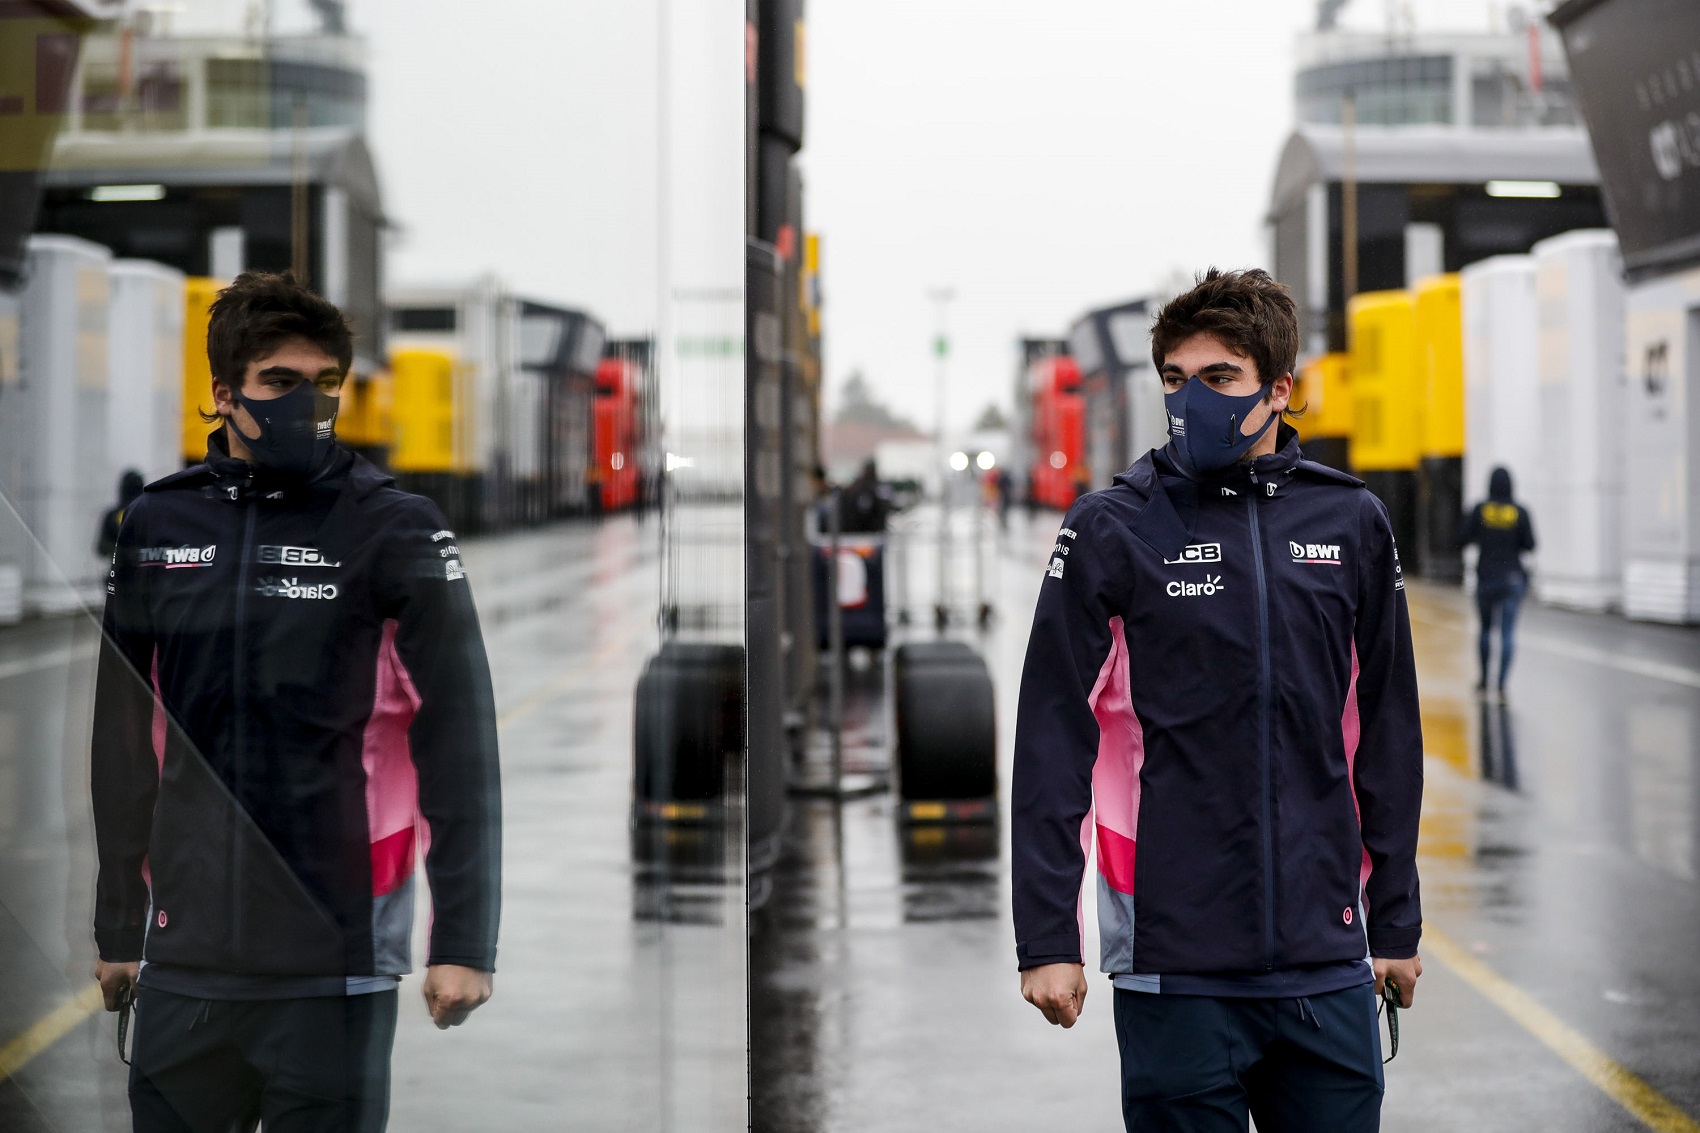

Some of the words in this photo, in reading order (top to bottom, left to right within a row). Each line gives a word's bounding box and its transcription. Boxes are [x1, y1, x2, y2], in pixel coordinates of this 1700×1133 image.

[1168, 545, 1220, 562] CB
[1306, 544, 1341, 560] BWT
[1166, 580, 1216, 597] Claro
